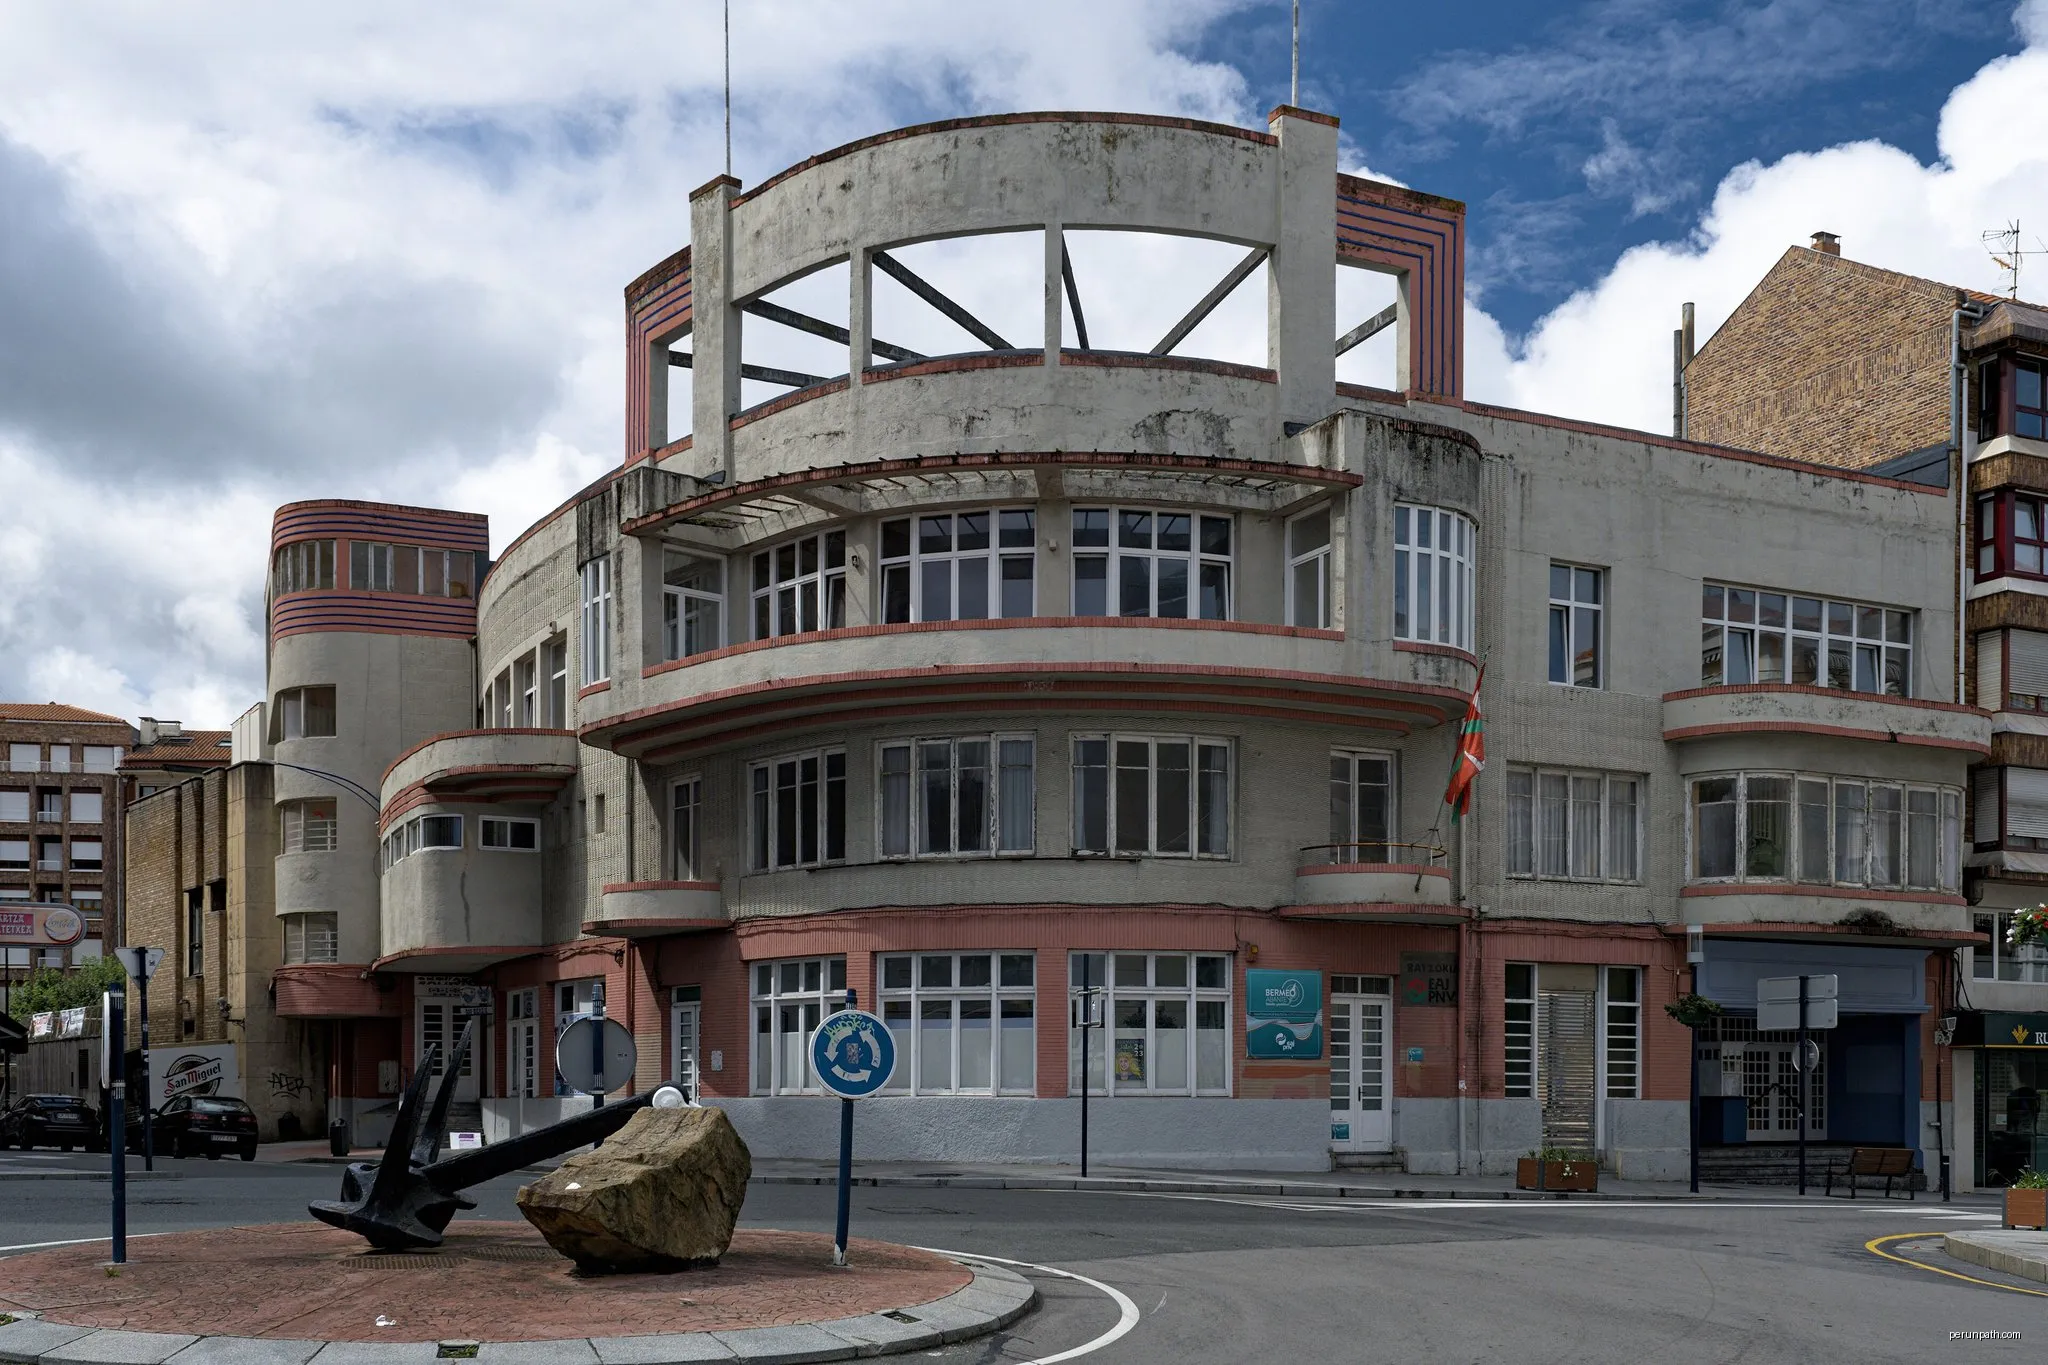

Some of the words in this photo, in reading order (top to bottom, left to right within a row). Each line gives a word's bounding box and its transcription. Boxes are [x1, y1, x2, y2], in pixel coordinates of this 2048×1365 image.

[1429, 978, 1449, 990] EAJ
[1265, 984, 1297, 997] BERMEO
[1428, 991, 1457, 1003] PNV
[164, 1078, 187, 1095] San
[186, 1062, 222, 1084] Miguel
